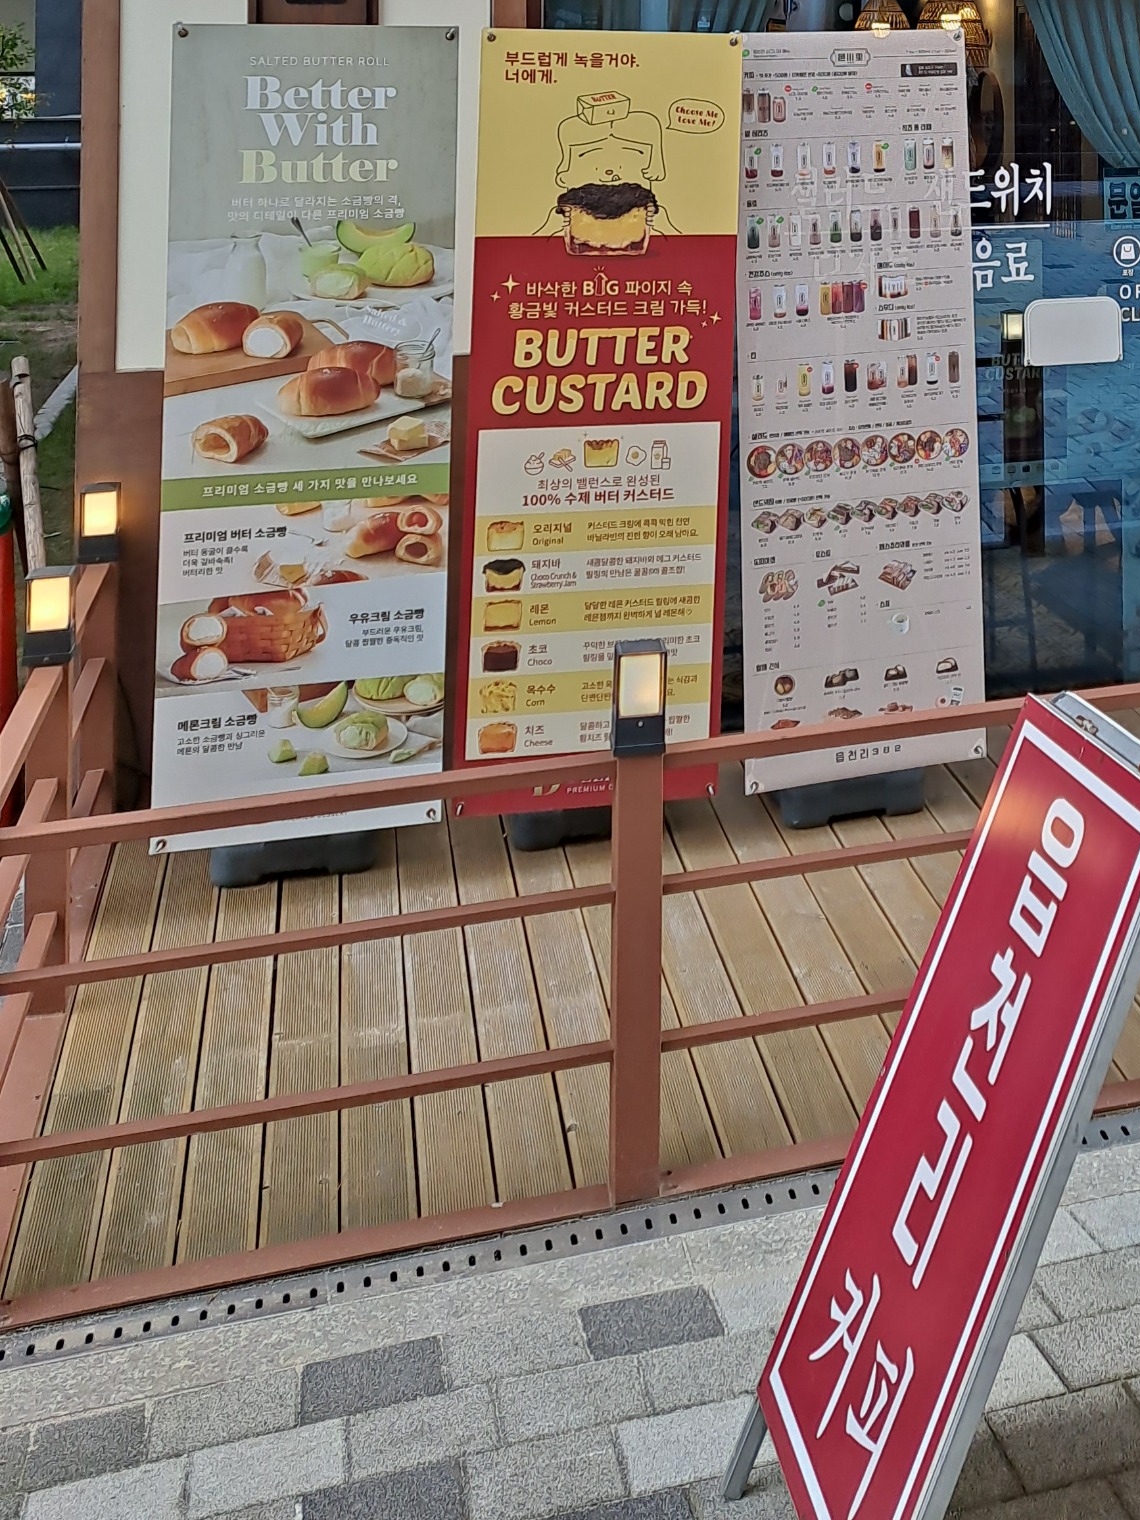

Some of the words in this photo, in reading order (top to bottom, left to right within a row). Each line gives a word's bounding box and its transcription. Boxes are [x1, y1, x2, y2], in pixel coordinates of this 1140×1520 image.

[250, 57, 298, 66] SALTED
[303, 57, 353, 66] BUTTER
[358, 57, 389, 66] ROLL
[505, 51, 568, 67] 부드럽게
[573, 52, 640, 68] 녹을거야.
[505, 68, 558, 84] 너에게.
[242, 75, 397, 110] Better
[591, 93, 617, 102] BUTTER
[676, 106, 703, 116] Choose
[678, 116, 696, 124] Love
[699, 117, 716, 126] Me!
[258, 112, 379, 146] With
[240, 149, 398, 183] Butter
[231, 198, 253, 207] 버터
[258, 197, 290, 207] 하나로
[294, 196, 337, 207] 달라지는
[341, 195, 384, 206] 소금빵의
[228, 210, 249, 222] 맛의
[253, 210, 297, 221] 디테일이
[301, 210, 323, 220] 다른
[327, 209, 369, 220] 프리미엄
[373, 208, 405, 219] 소금빵
[972, 237, 1035, 291] 음료
[526, 280, 577, 296] 바삭한
[624, 280, 671, 296] 파이지
[676, 280, 693, 295] 속
[508, 302, 558, 319] 황금빛
[563, 301, 628, 317] 커스터드
[632, 300, 665, 316] 크림
[669, 299, 707, 315] 가득!
[512, 326, 692, 368] BUTTER
[491, 370, 708, 415] CUSTARD
[202, 483, 249, 497] 프리미엄
[253, 481, 288, 494] 소금빵
[293, 480, 304, 492] 세
[307, 479, 330, 491] 가지
[335, 477, 357, 489] 맛을
[361, 474, 418, 487] 만나보세요
[538, 478, 573, 491] 최상의
[576, 476, 623, 490] 밸런스로
[626, 474, 660, 487] 완성된
[522, 494, 561, 507] 100%
[564, 491, 590, 505] 수제
[594, 490, 619, 503] 버터
[623, 488, 674, 501] 커스터드
[184, 530, 227, 543] 프리미엄
[231, 529, 252, 540] 버터
[254, 526, 287, 538] 소금빵
[533, 522, 572, 534] 오리지널
[533, 537, 563, 546] Original
[532, 558, 560, 569] 돼지바
[550, 572, 571, 580] Crunch
[529, 603, 549, 614] 레몬
[349, 611, 390, 624] 우유크림
[393, 608, 424, 620] 소금빵
[529, 618, 557, 626] Lemon
[528, 645, 548, 654] 초코
[527, 658, 553, 666] Choco
[526, 683, 556, 694] 옥수수
[526, 698, 545, 707] Corn
[178, 717, 221, 731] 메론크림
[224, 714, 257, 726] 소금빵
[524, 725, 544, 736] 치즈
[524, 739, 553, 748] Cheese
[566, 784, 606, 794] PREMIUM
[808, 1267, 917, 1520] 커피
